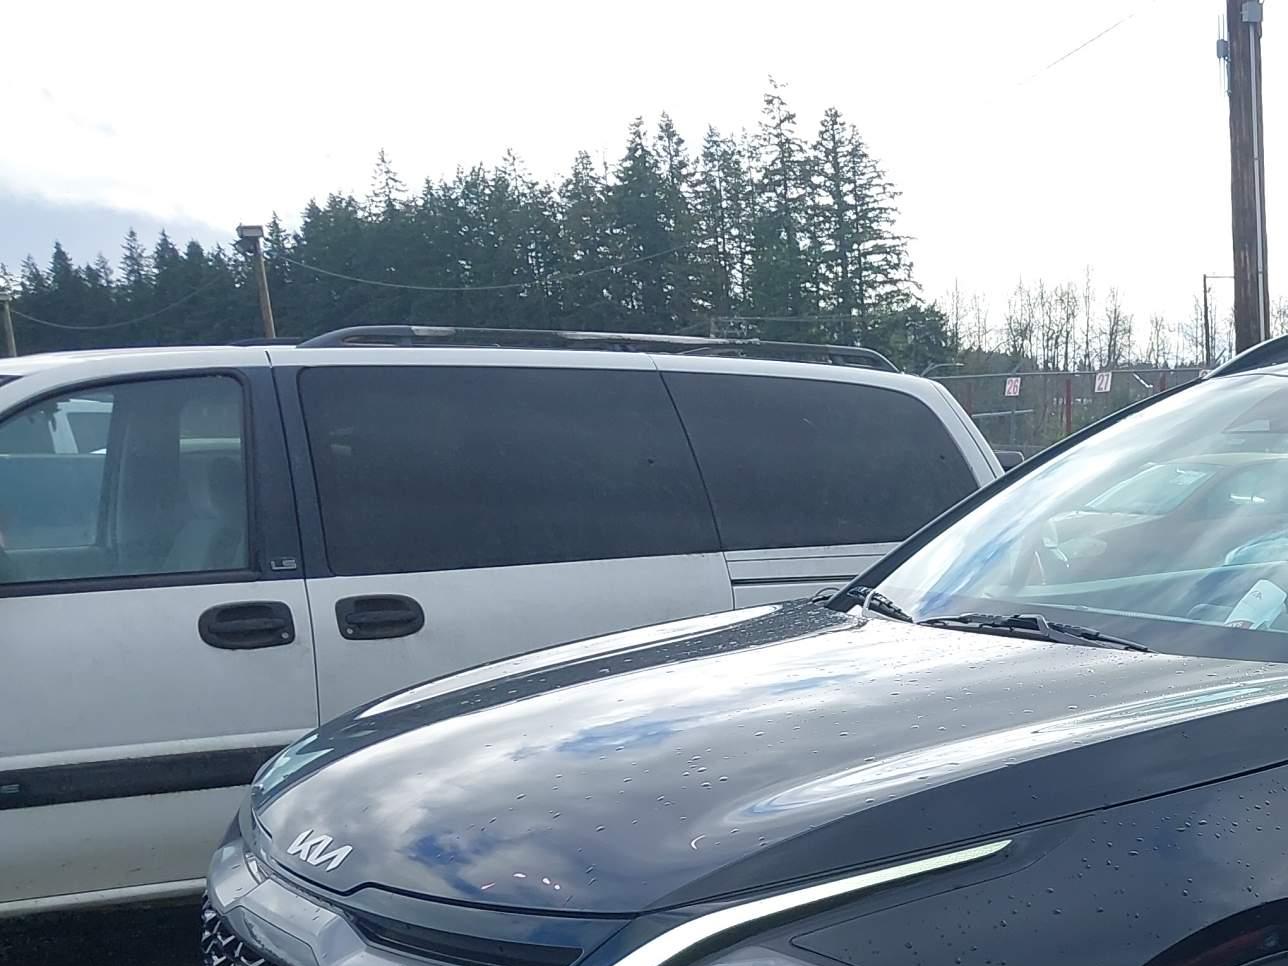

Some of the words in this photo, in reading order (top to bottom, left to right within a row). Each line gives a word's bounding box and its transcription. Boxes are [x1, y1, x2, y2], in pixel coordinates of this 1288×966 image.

[1007, 379, 1019, 394] 26
[1097, 374, 1110, 391] 27
[271, 559, 297, 570] LS
[287, 829, 353, 872] KIA
